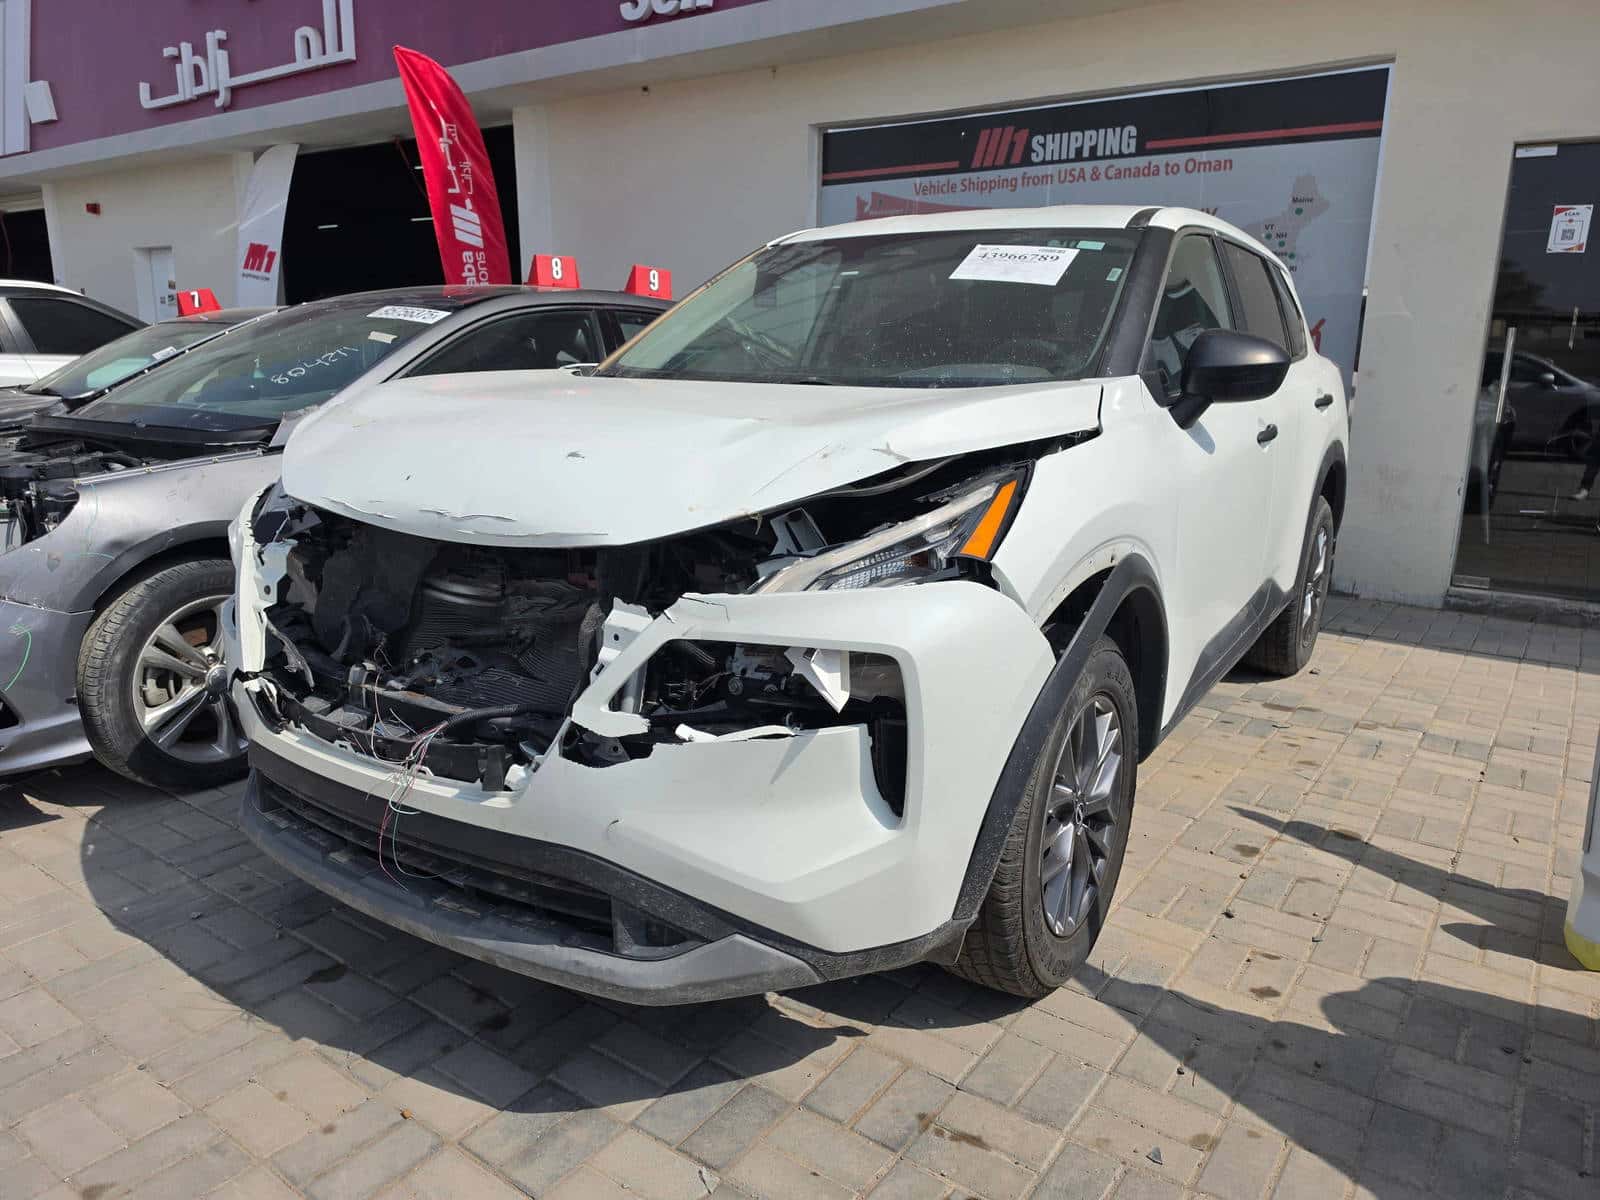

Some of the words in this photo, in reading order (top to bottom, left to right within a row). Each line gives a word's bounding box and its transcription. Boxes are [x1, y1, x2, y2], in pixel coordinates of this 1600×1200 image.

[1030, 125, 1137, 163] SHIPPING
[913, 180, 958, 196] Vehicle
[960, 174, 1018, 194] Shipping
[1020, 171, 1053, 187] from
[1057, 168, 1086, 185] USA
[1090, 166, 1101, 182] &
[1104, 160, 1160, 180] Canada
[1164, 160, 1179, 176] to
[1184, 156, 1233, 174] Oman
[243, 242, 277, 273] M1
[551, 257, 563, 280] 8
[649, 269, 660, 291] 9
